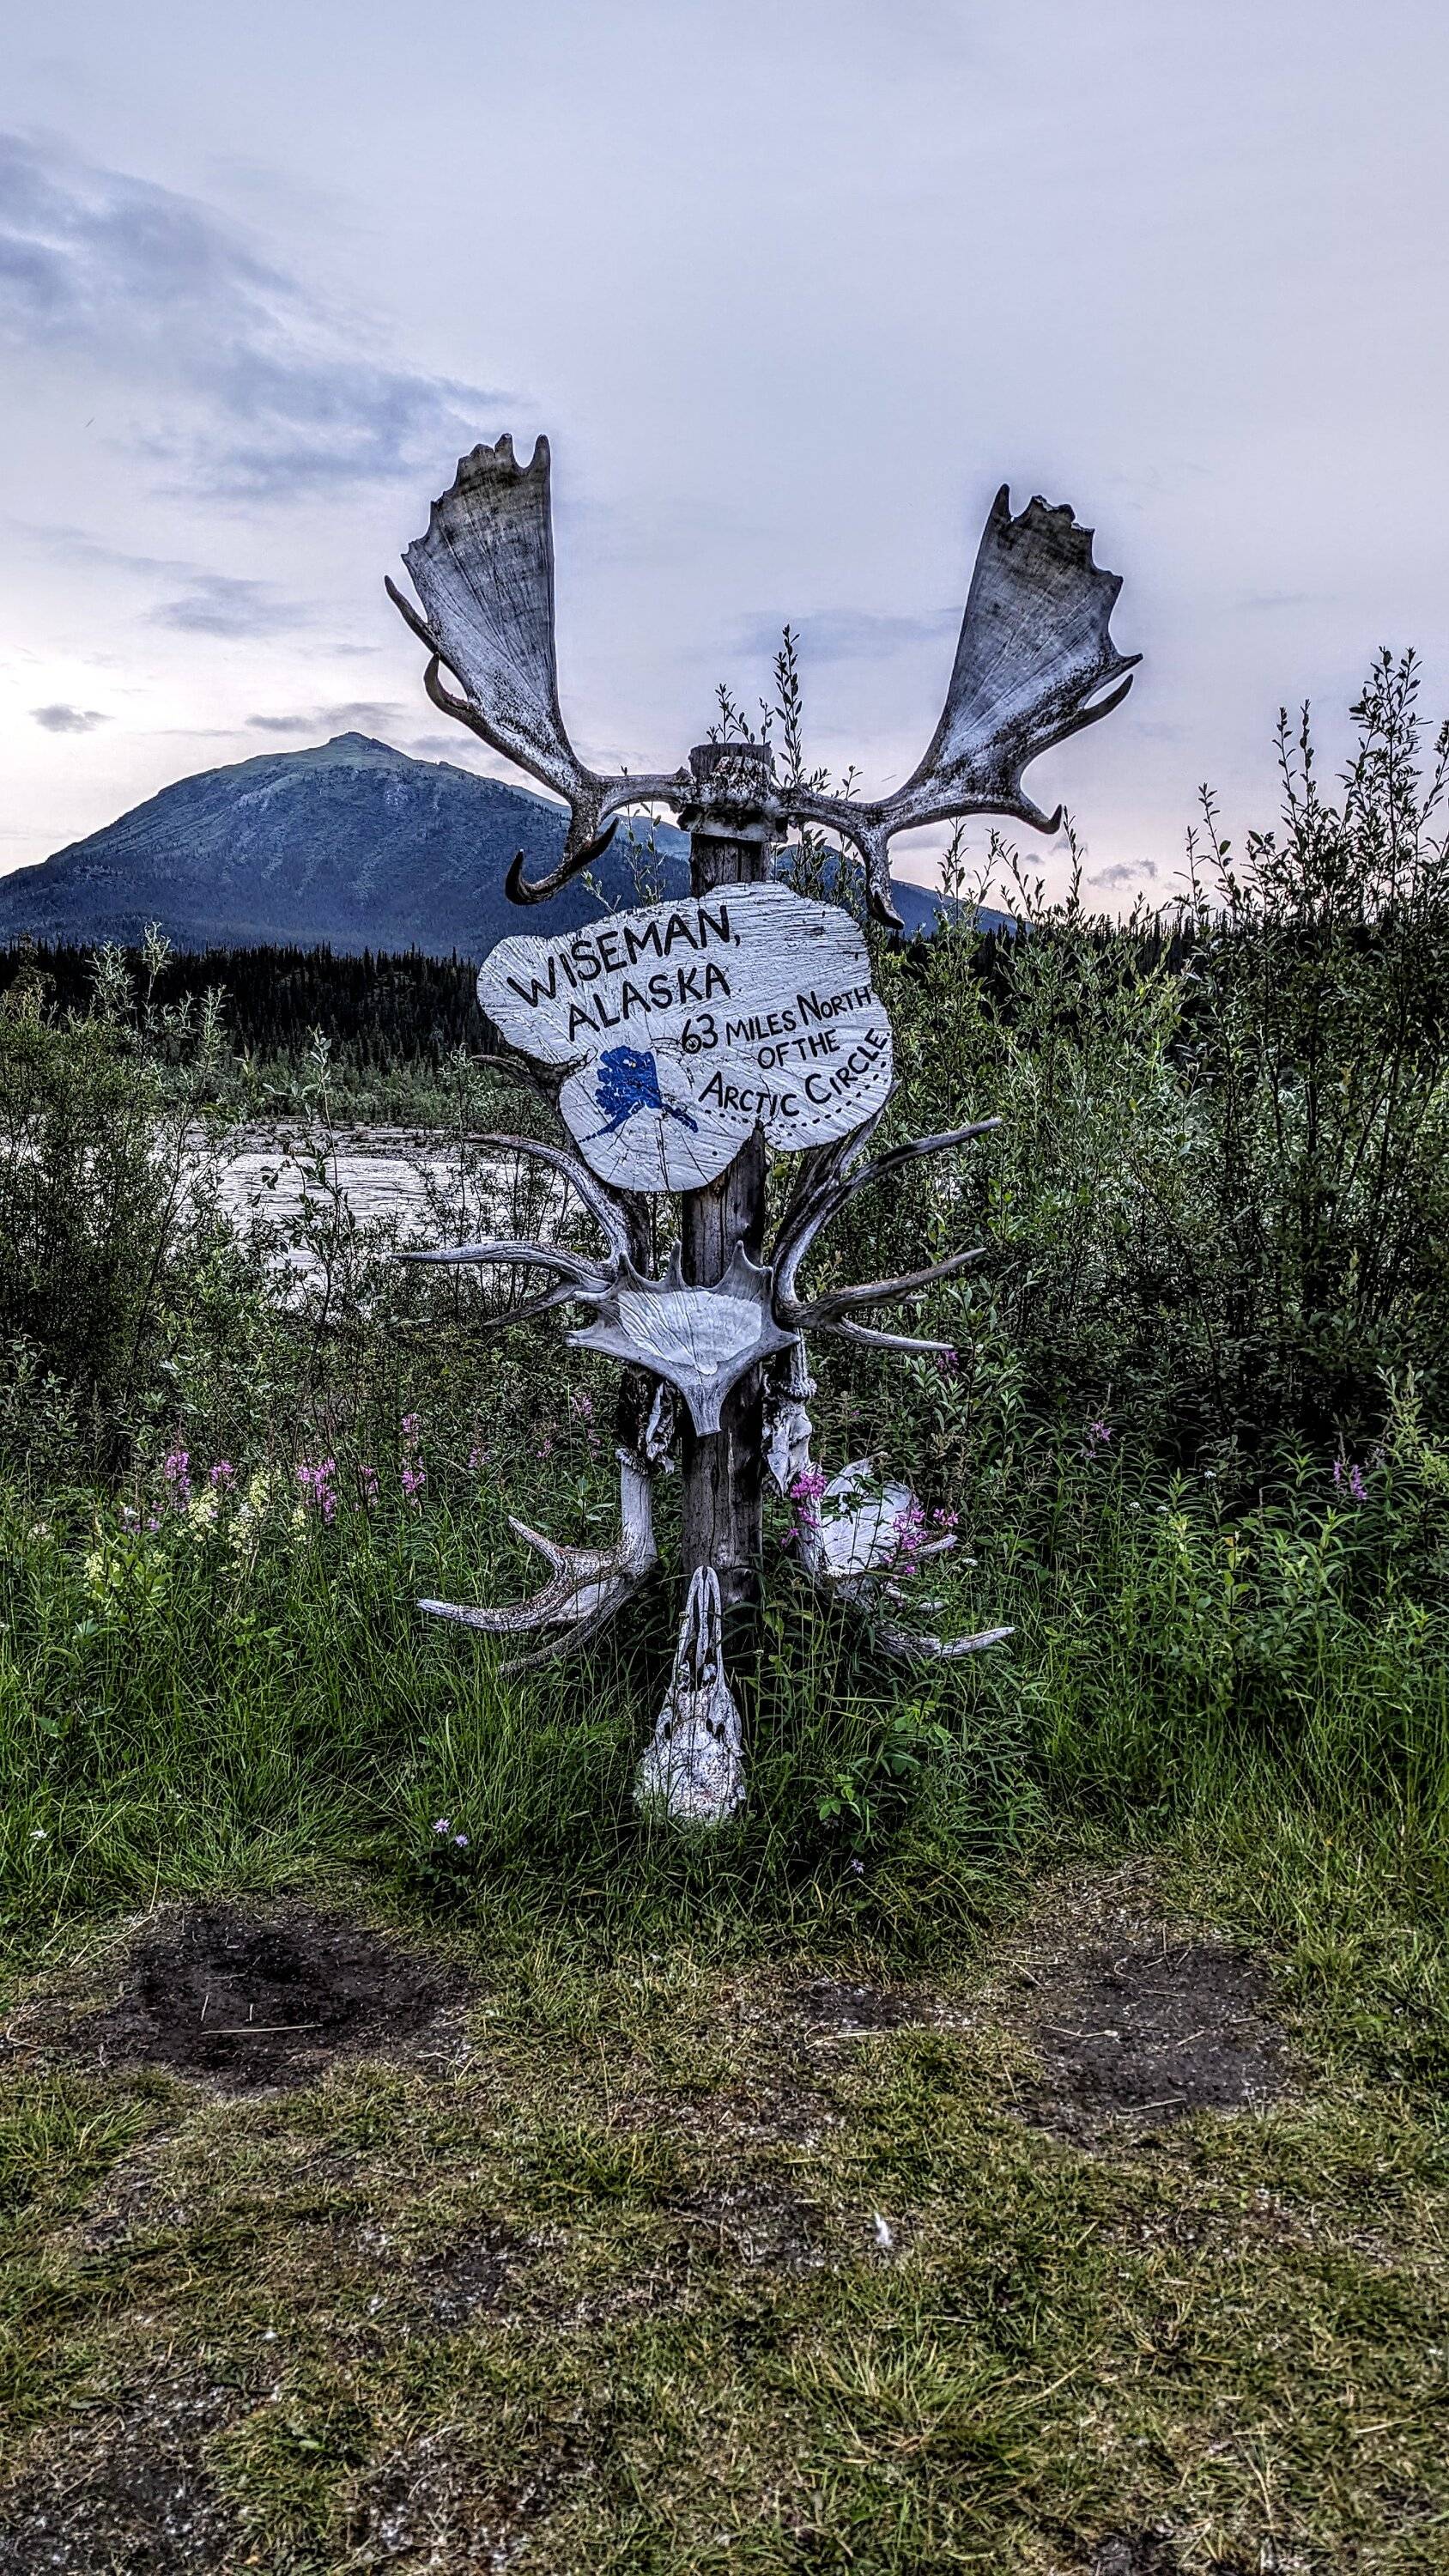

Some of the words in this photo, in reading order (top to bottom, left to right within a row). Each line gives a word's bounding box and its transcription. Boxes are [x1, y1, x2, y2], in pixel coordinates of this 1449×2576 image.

[506, 905, 741, 1007] WISEMAN,
[568, 963, 731, 1042] ALASKA
[682, 1013, 718, 1054] 63
[726, 1010, 797, 1046] MILES
[758, 1042, 790, 1070] OF
[791, 1029, 840, 1060] THE
